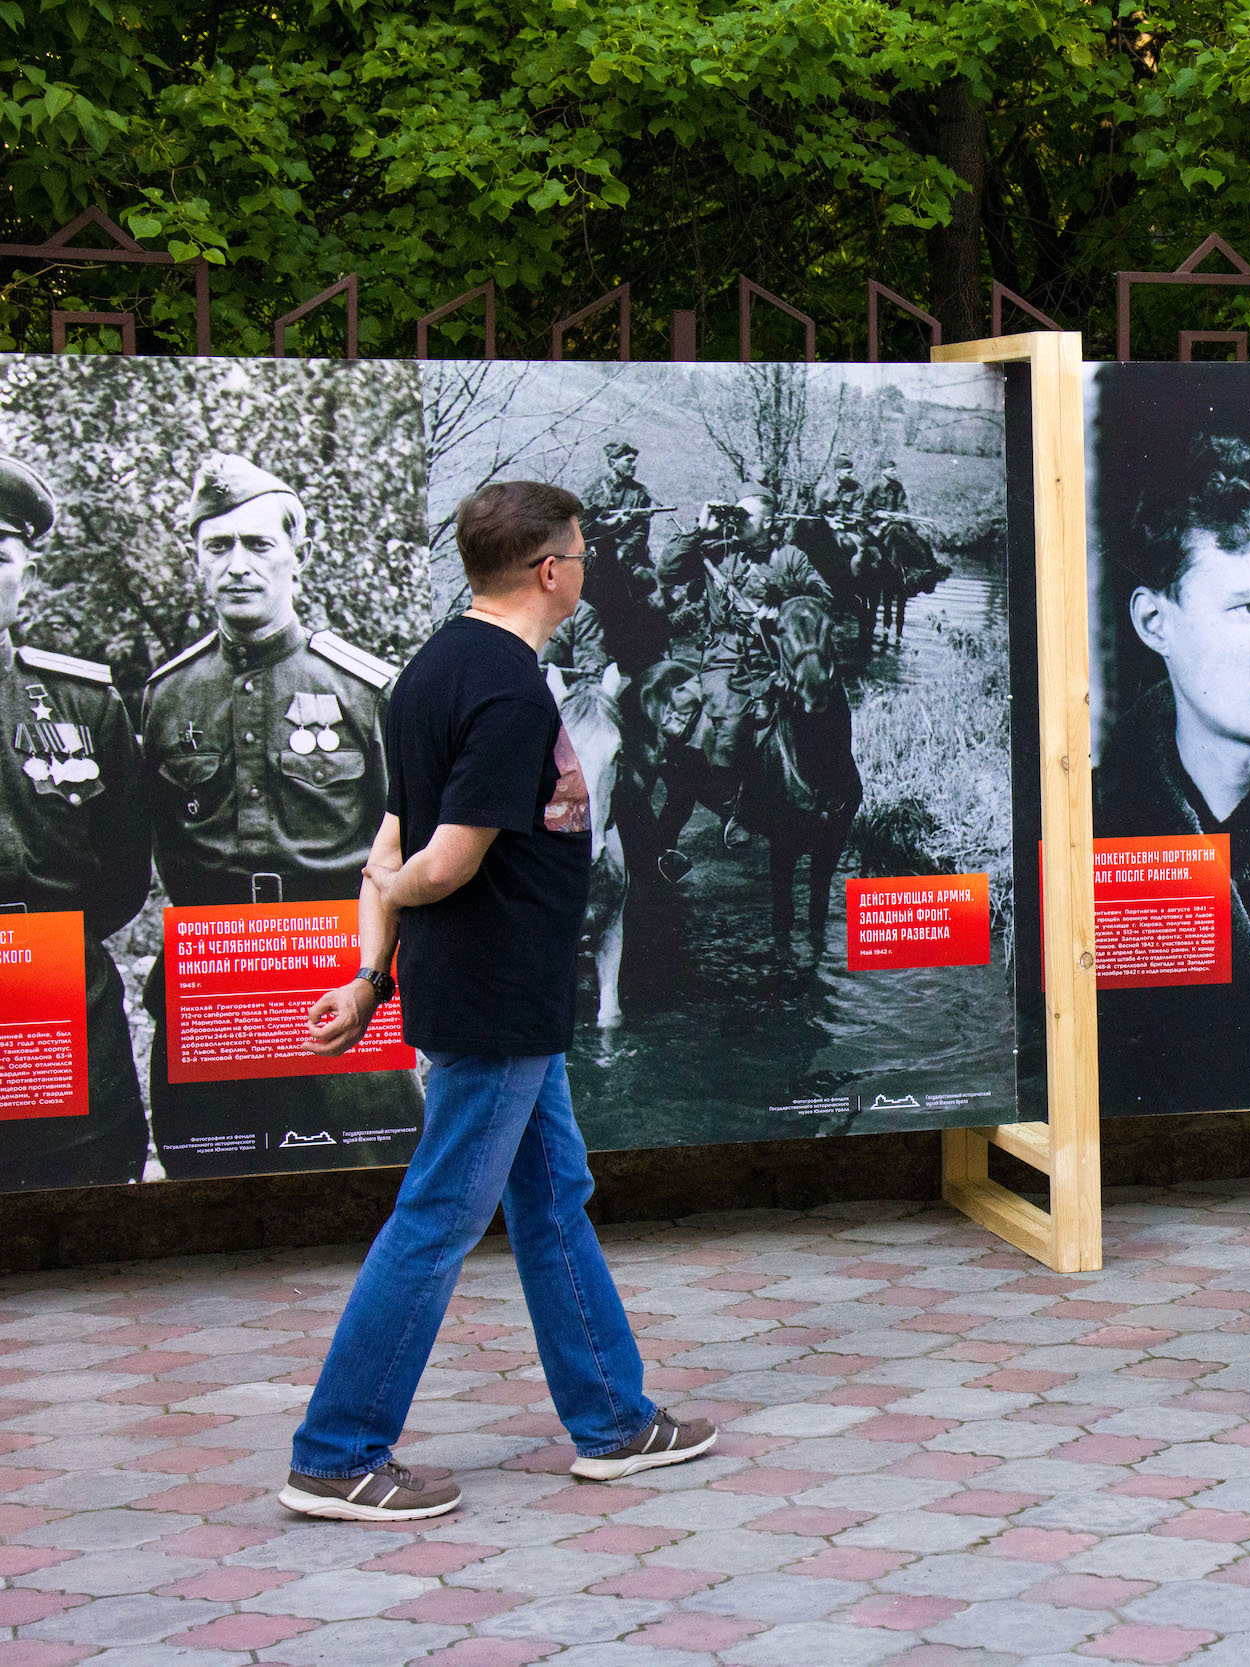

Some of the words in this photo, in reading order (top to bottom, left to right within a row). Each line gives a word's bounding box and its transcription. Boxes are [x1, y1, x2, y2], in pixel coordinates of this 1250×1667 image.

[1093, 851, 1159, 865] НОКЕНТЬЕВИЧ
[1163, 849, 1215, 862] ПОРТНЯГИН
[1116, 870, 1144, 882] ПОСЛЕ
[1148, 868, 1192, 881] РАНЕНИЯ.
[859, 891, 933, 907] ДЕЙСТВУЮЩАЯ
[937, 889, 974, 902] АРМИЯ.
[860, 908, 913, 924] ЗАПАДНЫЙ
[917, 908, 951, 921] ФРОНТ.
[178, 918, 245, 936] ФРОНТОВОЙ
[249, 916, 339, 933] КОРРЕСПОНДЕНТ
[860, 928, 898, 942] КОННАЯ
[901, 926, 950, 940] РАЗВЕДКА
[178, 940, 204, 955] 63-Й
[209, 936, 286, 954] ЧЕЛЯБИНСКОЙ
[291, 933, 347, 949] ТАНКОВОЙ
[0, 949, 31, 963] КОГО
[179, 958, 230, 975] НИКОЛАЙ
[234, 956, 308, 973] ГРИГОРЬЕВИЧ
[313, 955, 340, 968] ЧИЖ.
[217, 1003, 264, 1011] Григорьевич
[265, 1014, 309, 1023] конструктор
[181, 1026, 231, 1034] добровольцем
[254, 1029, 300, 1038] гвардейской)
[182, 1040, 250, 1049] добровольческого
[200, 1054, 232, 1062] танковой
[235, 1052, 264, 1060] бригады
[7, 1076, 72, 1084] противотанковые
